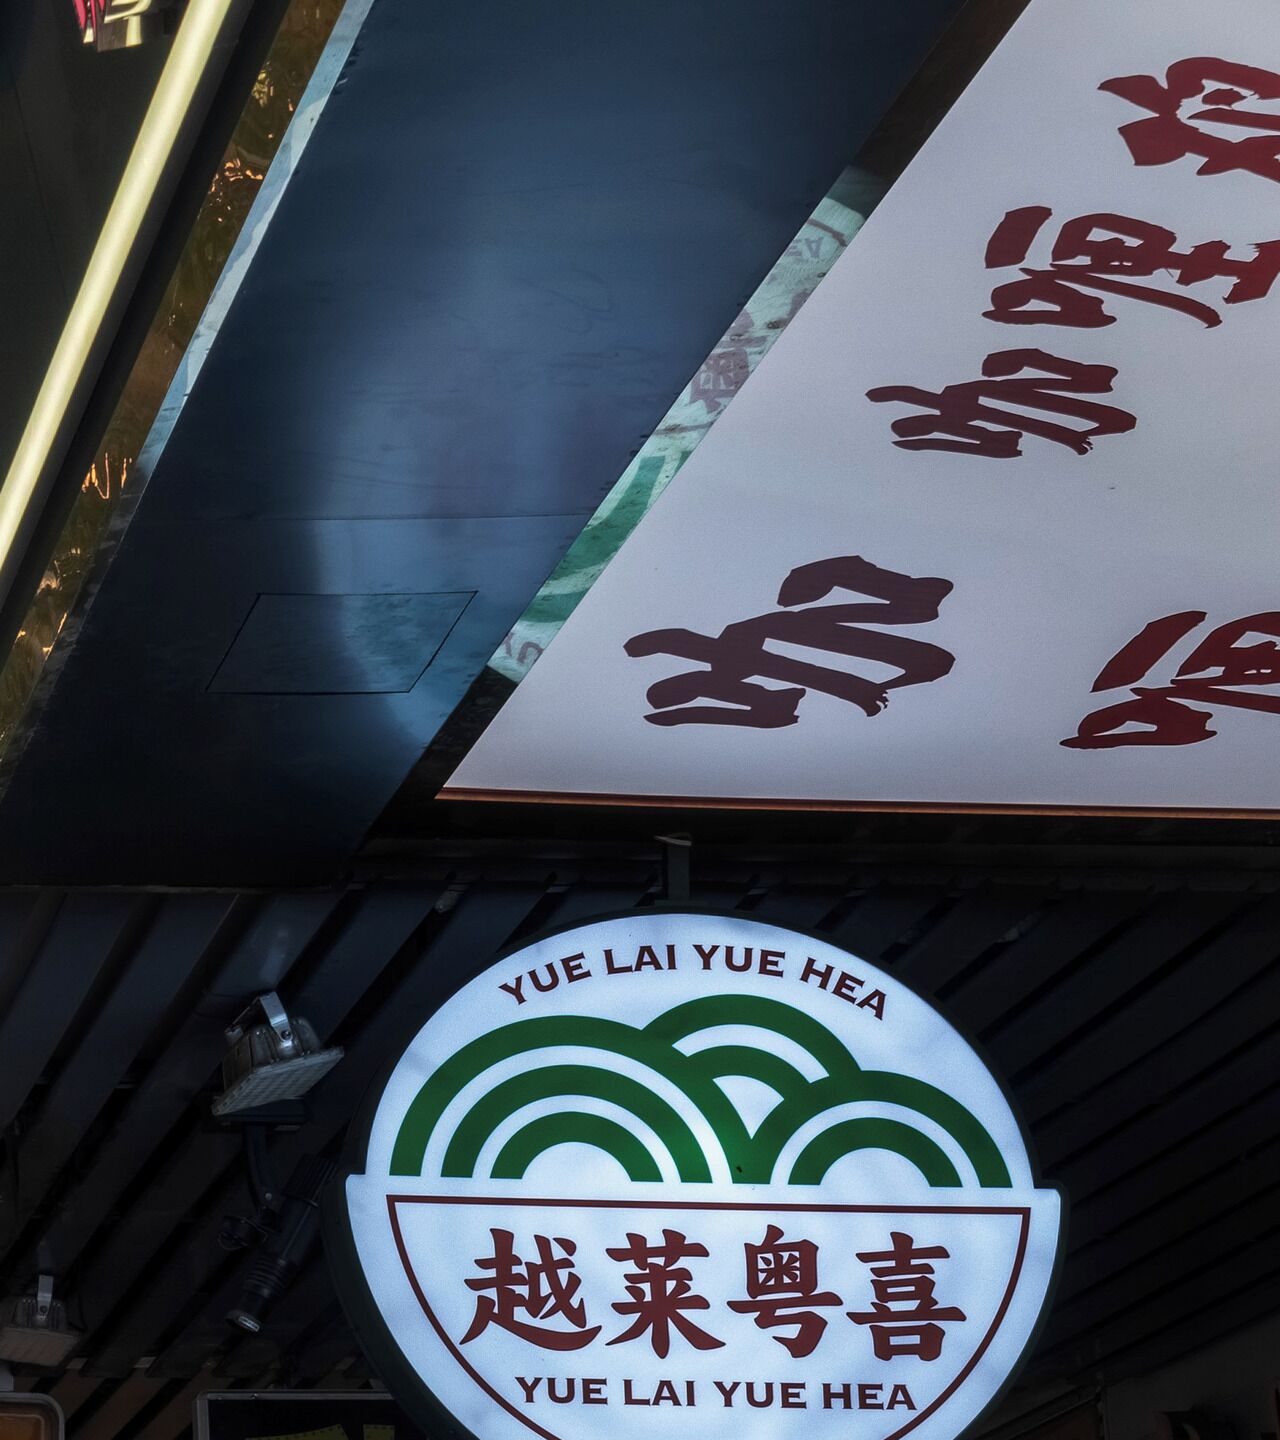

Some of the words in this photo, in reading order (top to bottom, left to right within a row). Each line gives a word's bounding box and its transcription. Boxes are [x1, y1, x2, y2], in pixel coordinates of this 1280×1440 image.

[498, 950, 593, 1006] YUE
[602, 943, 679, 975] LAI
[691, 943, 787, 977] YUE
[799, 957, 888, 1021] HEA
[459, 1223, 967, 1363] 越莱粤喜
[514, 1375, 609, 1406] YUE
[622, 1379, 698, 1407] LAI
[711, 1381, 807, 1411] YUE
[821, 1382, 918, 1412] HEA
